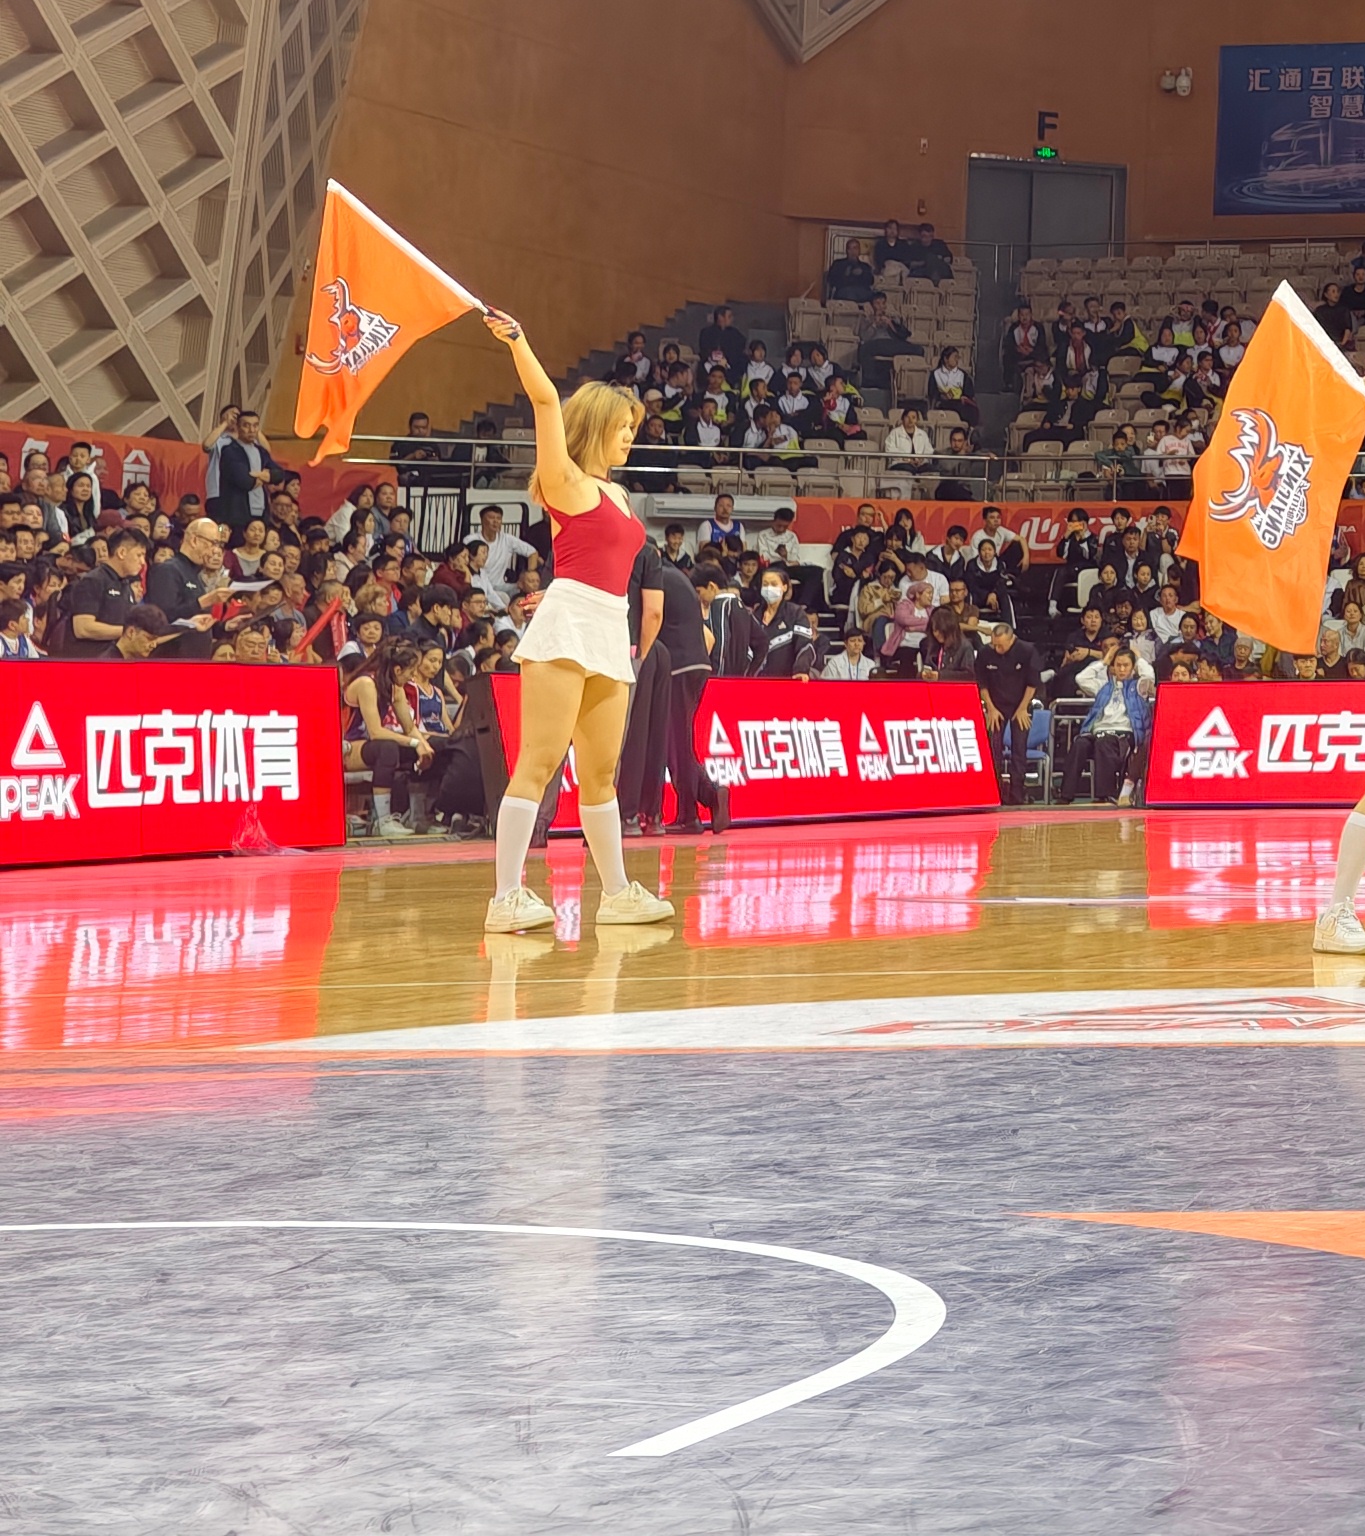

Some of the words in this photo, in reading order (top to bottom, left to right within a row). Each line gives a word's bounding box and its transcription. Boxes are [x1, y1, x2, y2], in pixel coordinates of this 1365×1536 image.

[1247, 65, 1365, 92] 汇通互联
[1037, 110, 1059, 141] F
[86, 709, 300, 808] 匹克体育
[737, 717, 849, 779] 匹克体育
[884, 716, 983, 775] 匹克体育
[1171, 749, 1254, 779] PEAK
[857, 754, 896, 781] PEAK
[0, 774, 81, 821] PEAK
